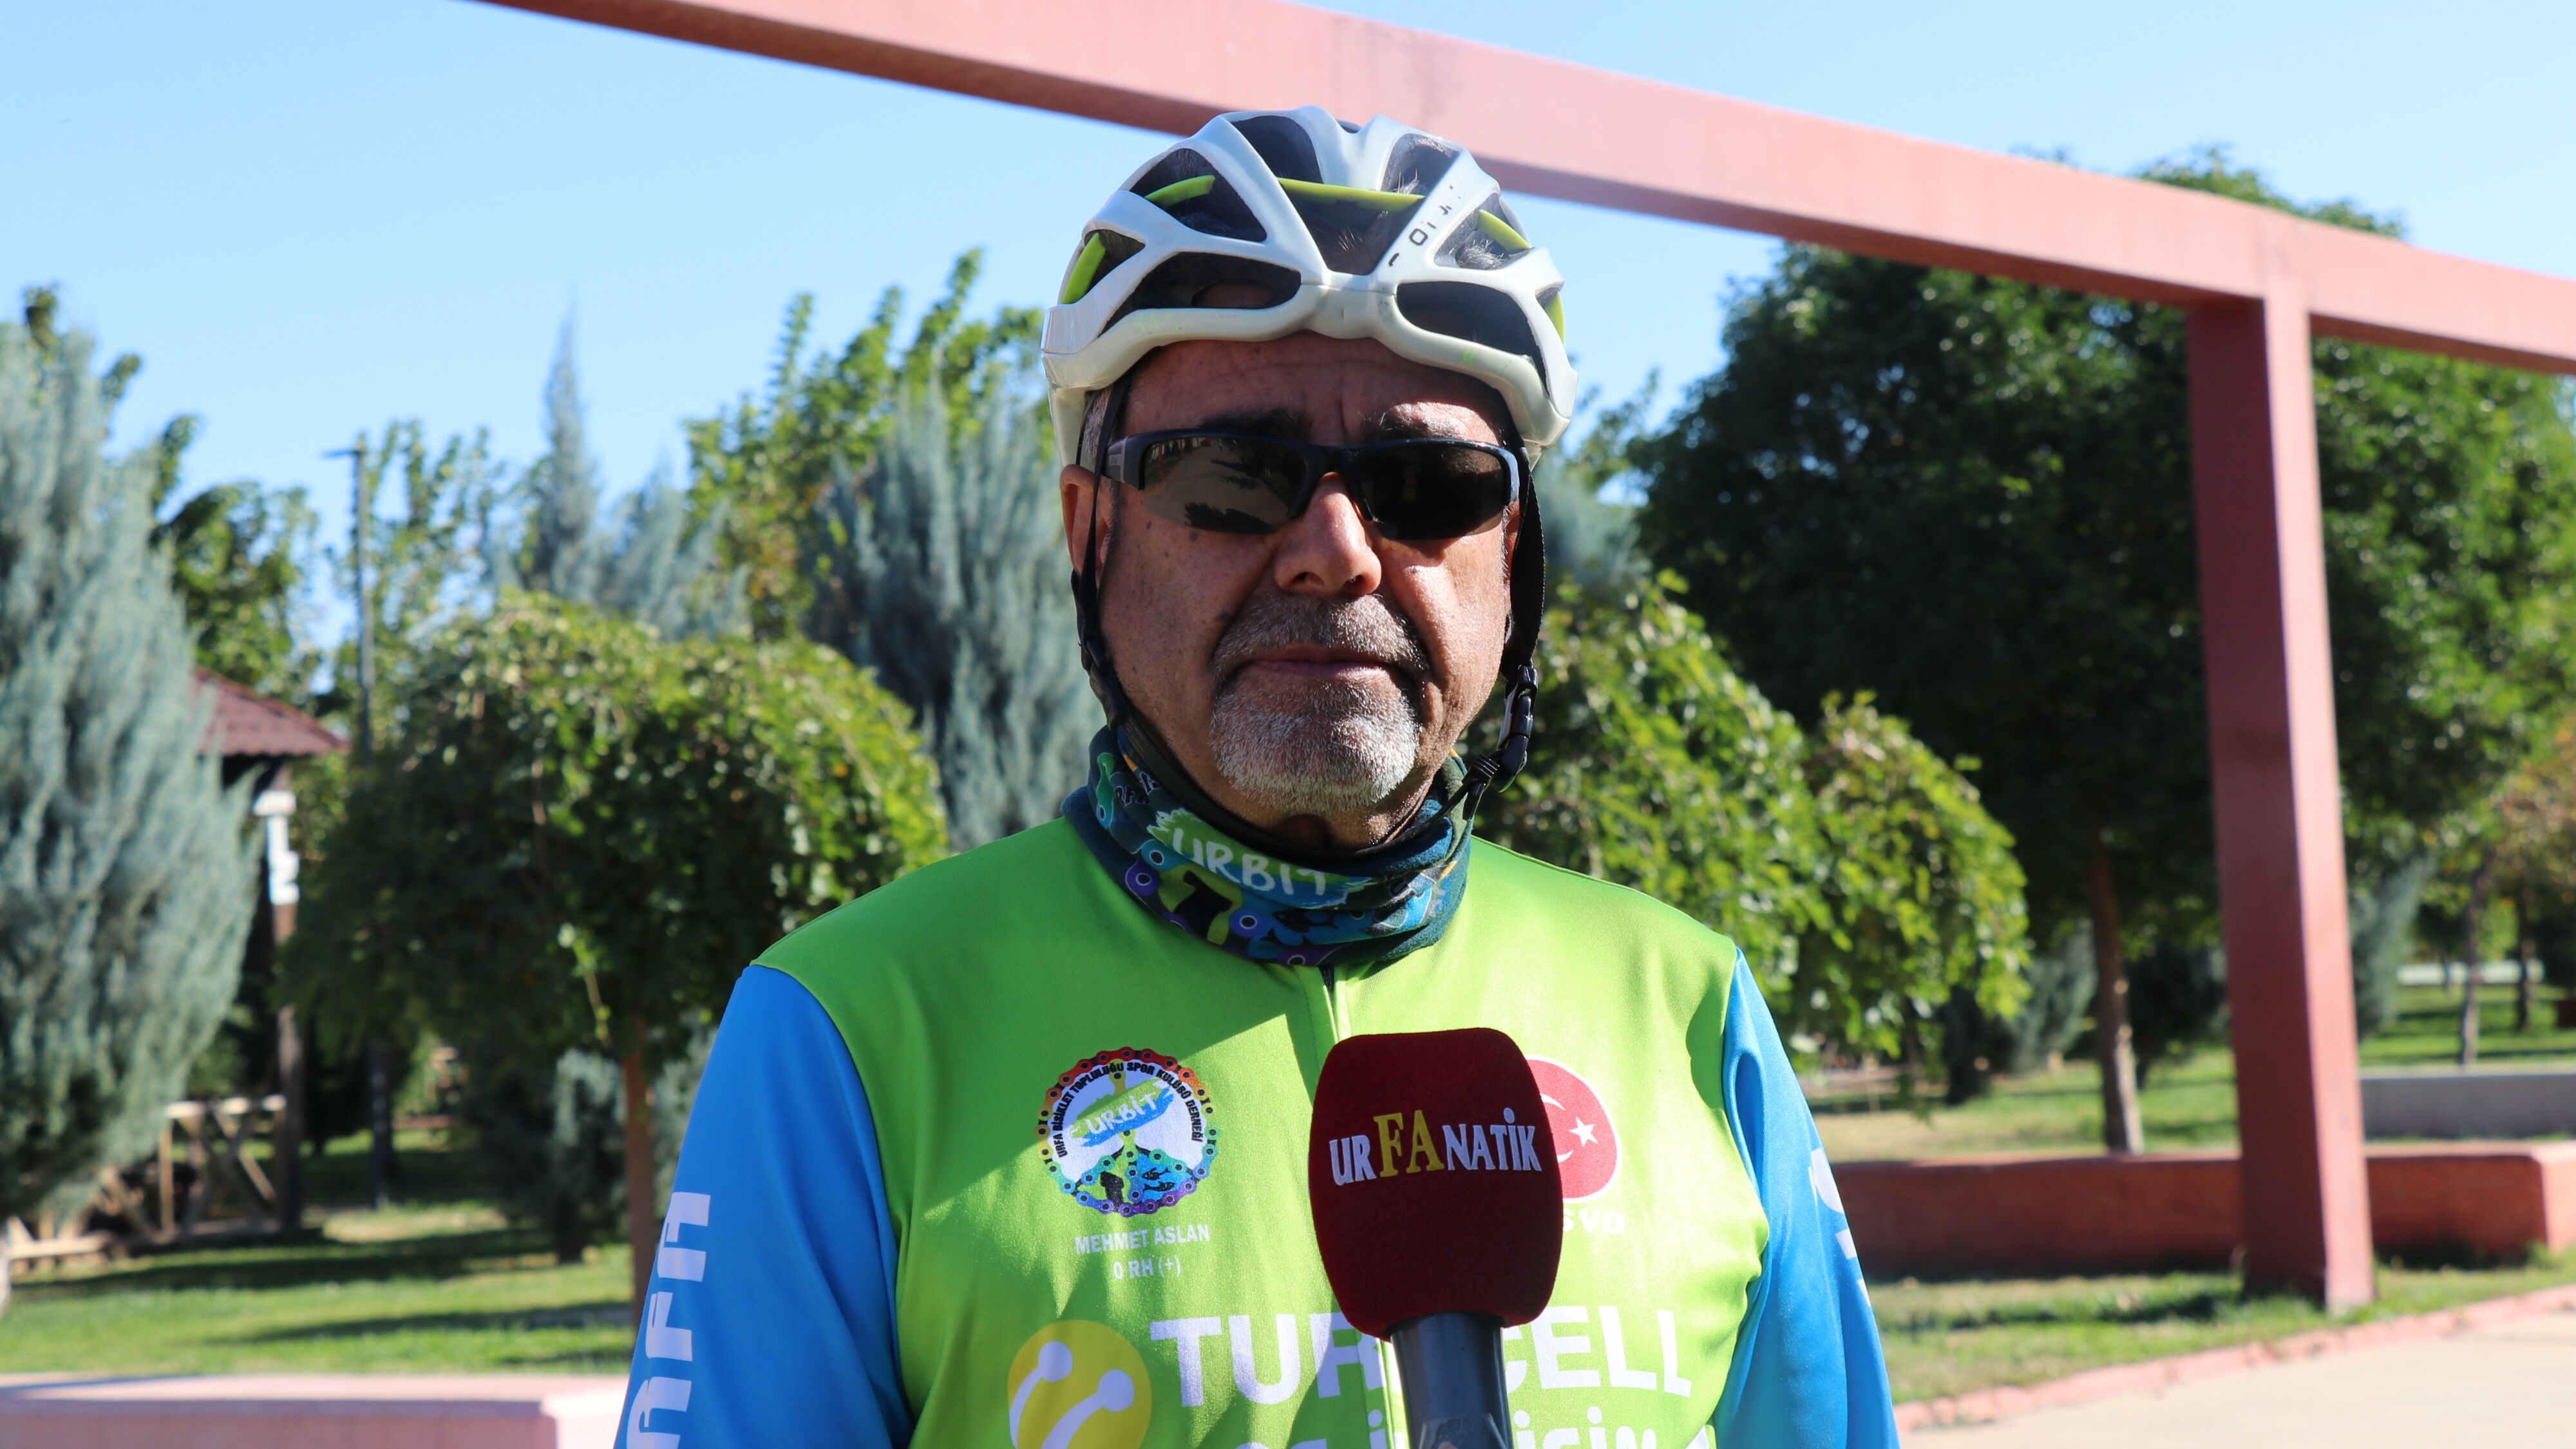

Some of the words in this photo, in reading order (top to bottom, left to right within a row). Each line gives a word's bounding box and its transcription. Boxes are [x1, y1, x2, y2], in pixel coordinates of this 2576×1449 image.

[1070, 1062, 1124, 1094] TOPLULUĞU
[1126, 1062, 1155, 1075] SPOR
[1156, 1069, 1192, 1099] KULÜBÜ
[1051, 1092, 1074, 1131] BİSİKLET
[1085, 1091, 1157, 1135] URBİT
[1053, 1133, 1068, 1158] URFA
[1074, 1229, 1148, 1255] MEHMET
[1154, 1224, 1211, 1245] ASLAN
[1128, 1258, 1154, 1278] RH
[1157, 1255, 1181, 1278] (+)
